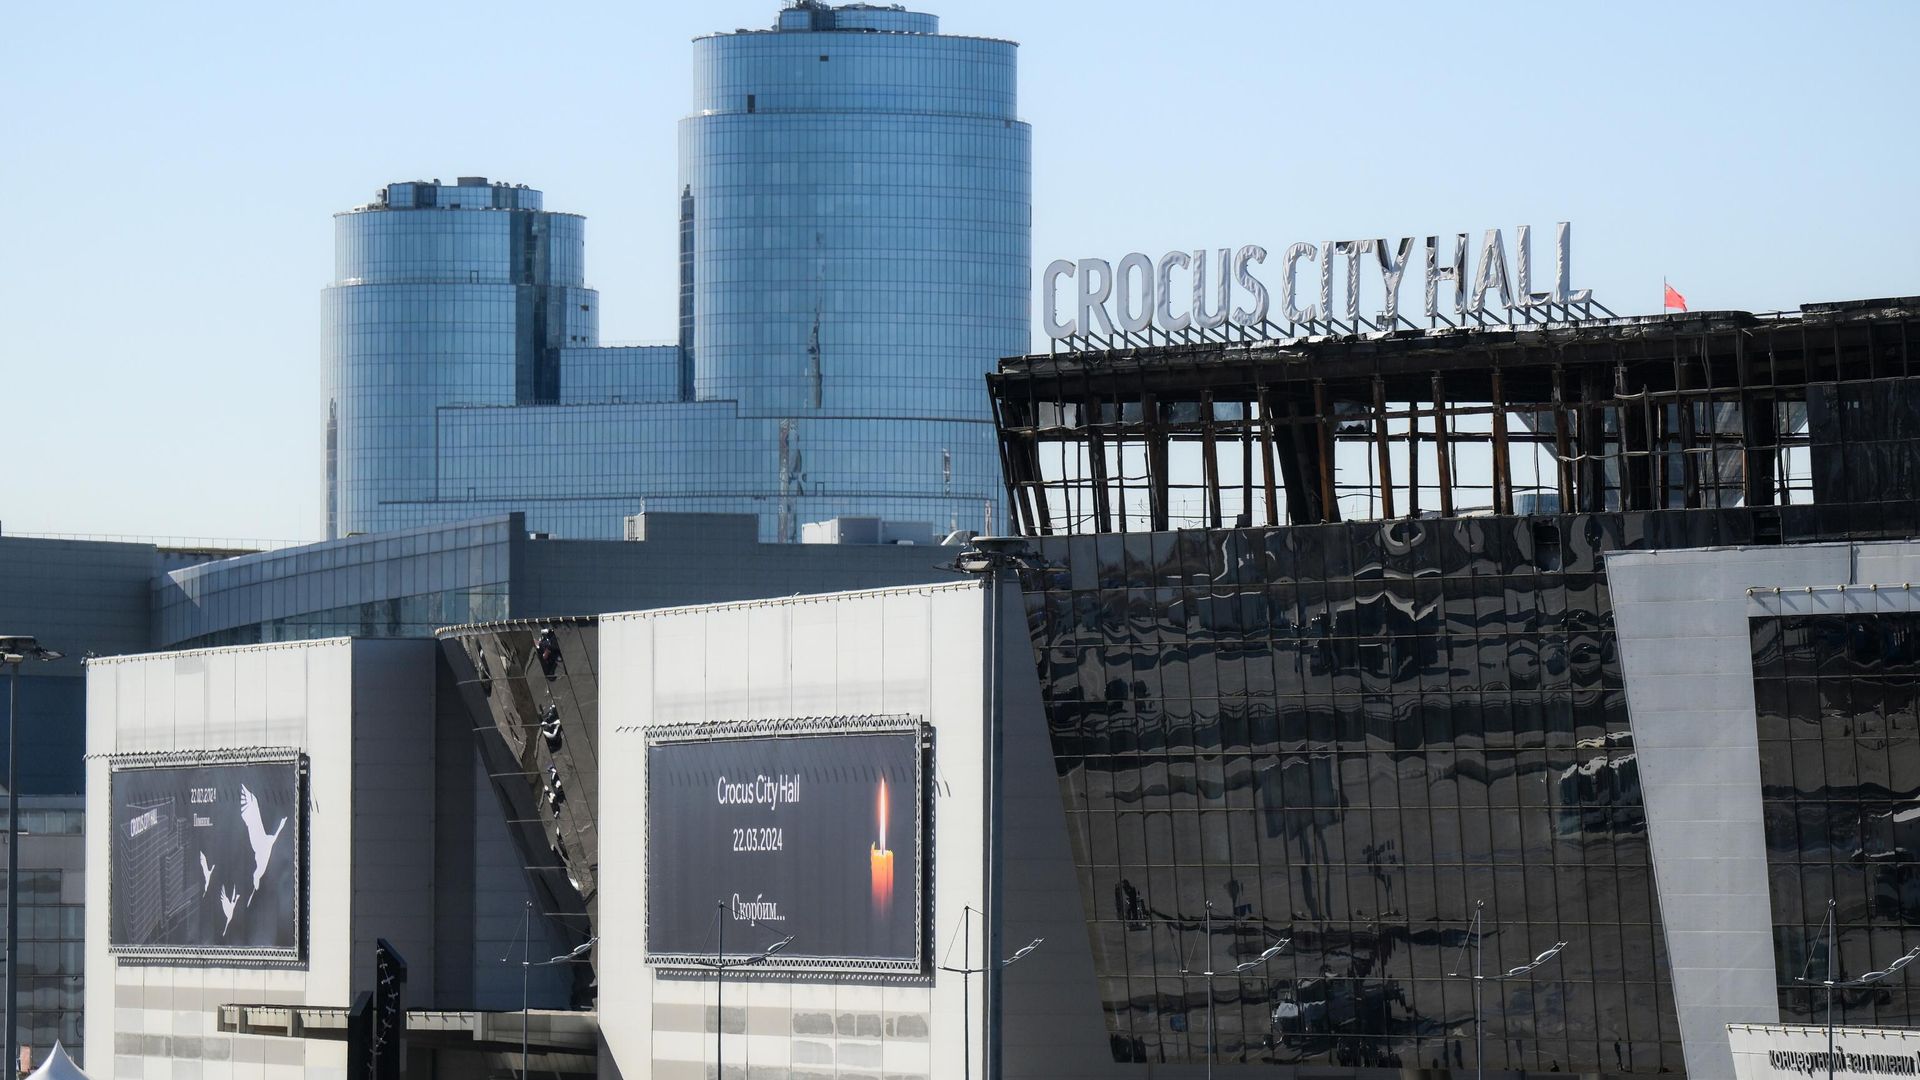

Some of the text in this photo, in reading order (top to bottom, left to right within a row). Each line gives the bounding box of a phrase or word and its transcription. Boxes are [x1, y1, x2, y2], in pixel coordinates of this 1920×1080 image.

[1043, 221, 1592, 339] CROCUS CITY HALL
[717, 774, 800, 811] Crocus City Hall
[733, 827, 783, 852] 22.03.2024
[732, 892, 785, 926] Скорбим...
[1846, 1053, 1871, 1074] зал
[1871, 1054, 1916, 1077] имени
